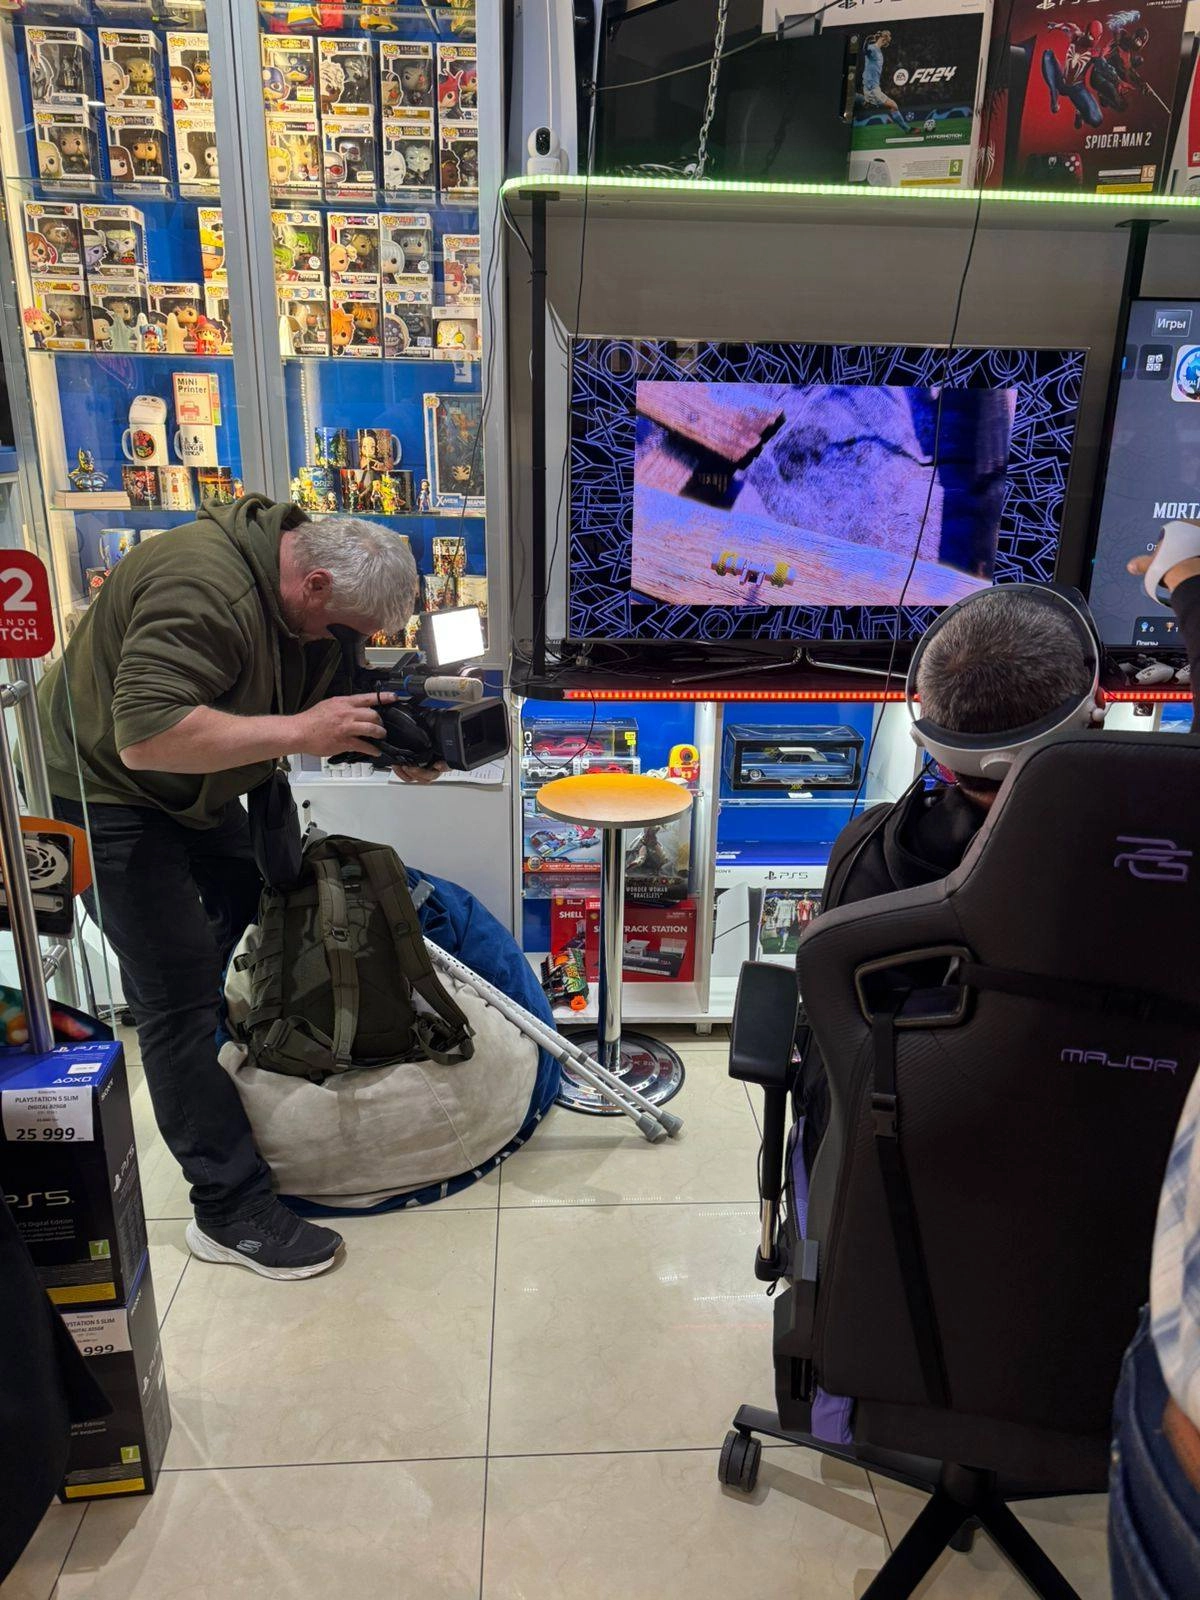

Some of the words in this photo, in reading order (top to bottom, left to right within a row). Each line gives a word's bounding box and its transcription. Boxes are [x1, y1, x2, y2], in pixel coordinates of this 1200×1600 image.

[1145, 131, 1153, 146] 2
[1142, 167, 1155, 178] 16
[1157, 318, 1186, 331] Игры
[178, 385, 207, 394] Printer
[779, 871, 809, 880] PS5
[559, 911, 584, 919] SHELL
[623, 925, 649, 933] RACK
[651, 925, 688, 933] STATION
[1060, 1048, 1179, 1076] MAJOR
[16, 1128, 37, 1140] 25
[42, 1127, 75, 1140] 999
